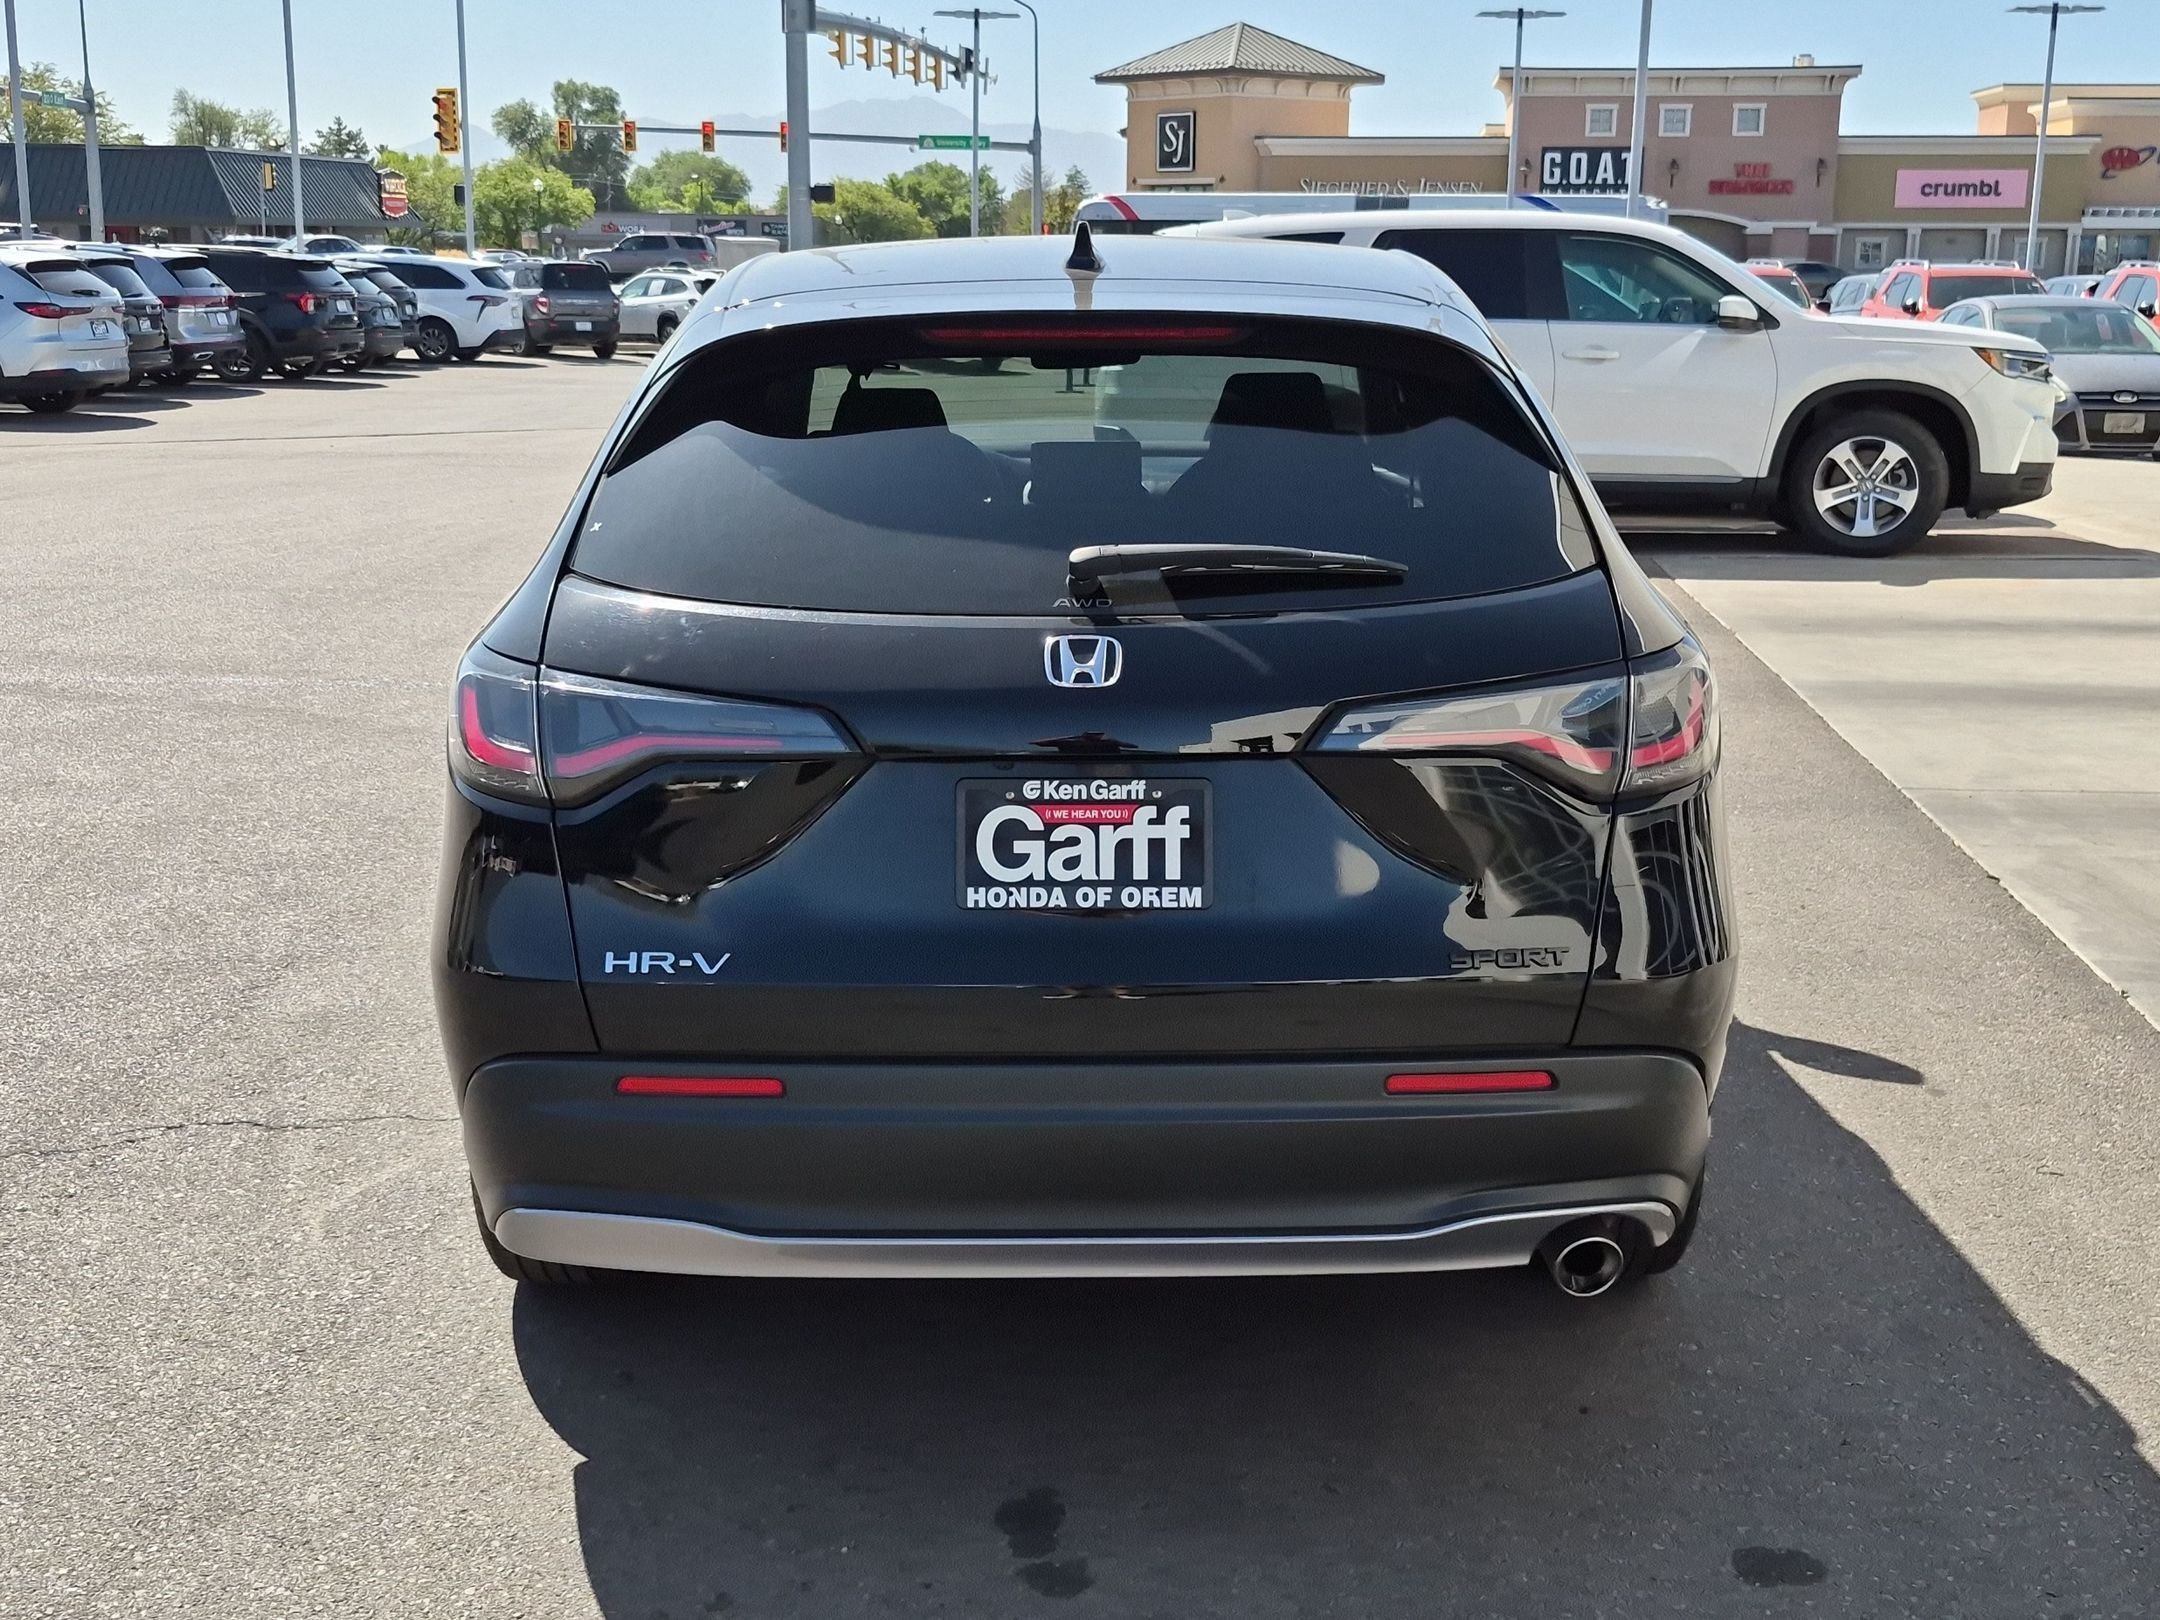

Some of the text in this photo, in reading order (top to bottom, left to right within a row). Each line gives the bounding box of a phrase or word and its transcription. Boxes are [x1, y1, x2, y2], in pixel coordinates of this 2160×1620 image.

[1393, 178, 1409, 196] &
[1419, 178, 1483, 194] JENSEN
[1920, 180, 2002, 197] crumbl
[1052, 598, 1113, 608] AWD
[1043, 780, 1147, 800] Ken Garff
[1053, 808, 1121, 819] WE HEAR YOU
[976, 804, 1190, 883] Garff
[966, 886, 1203, 908] HONDA OF OREM
[604, 951, 731, 974] HR-V
[1450, 947, 1569, 970] SPORT
